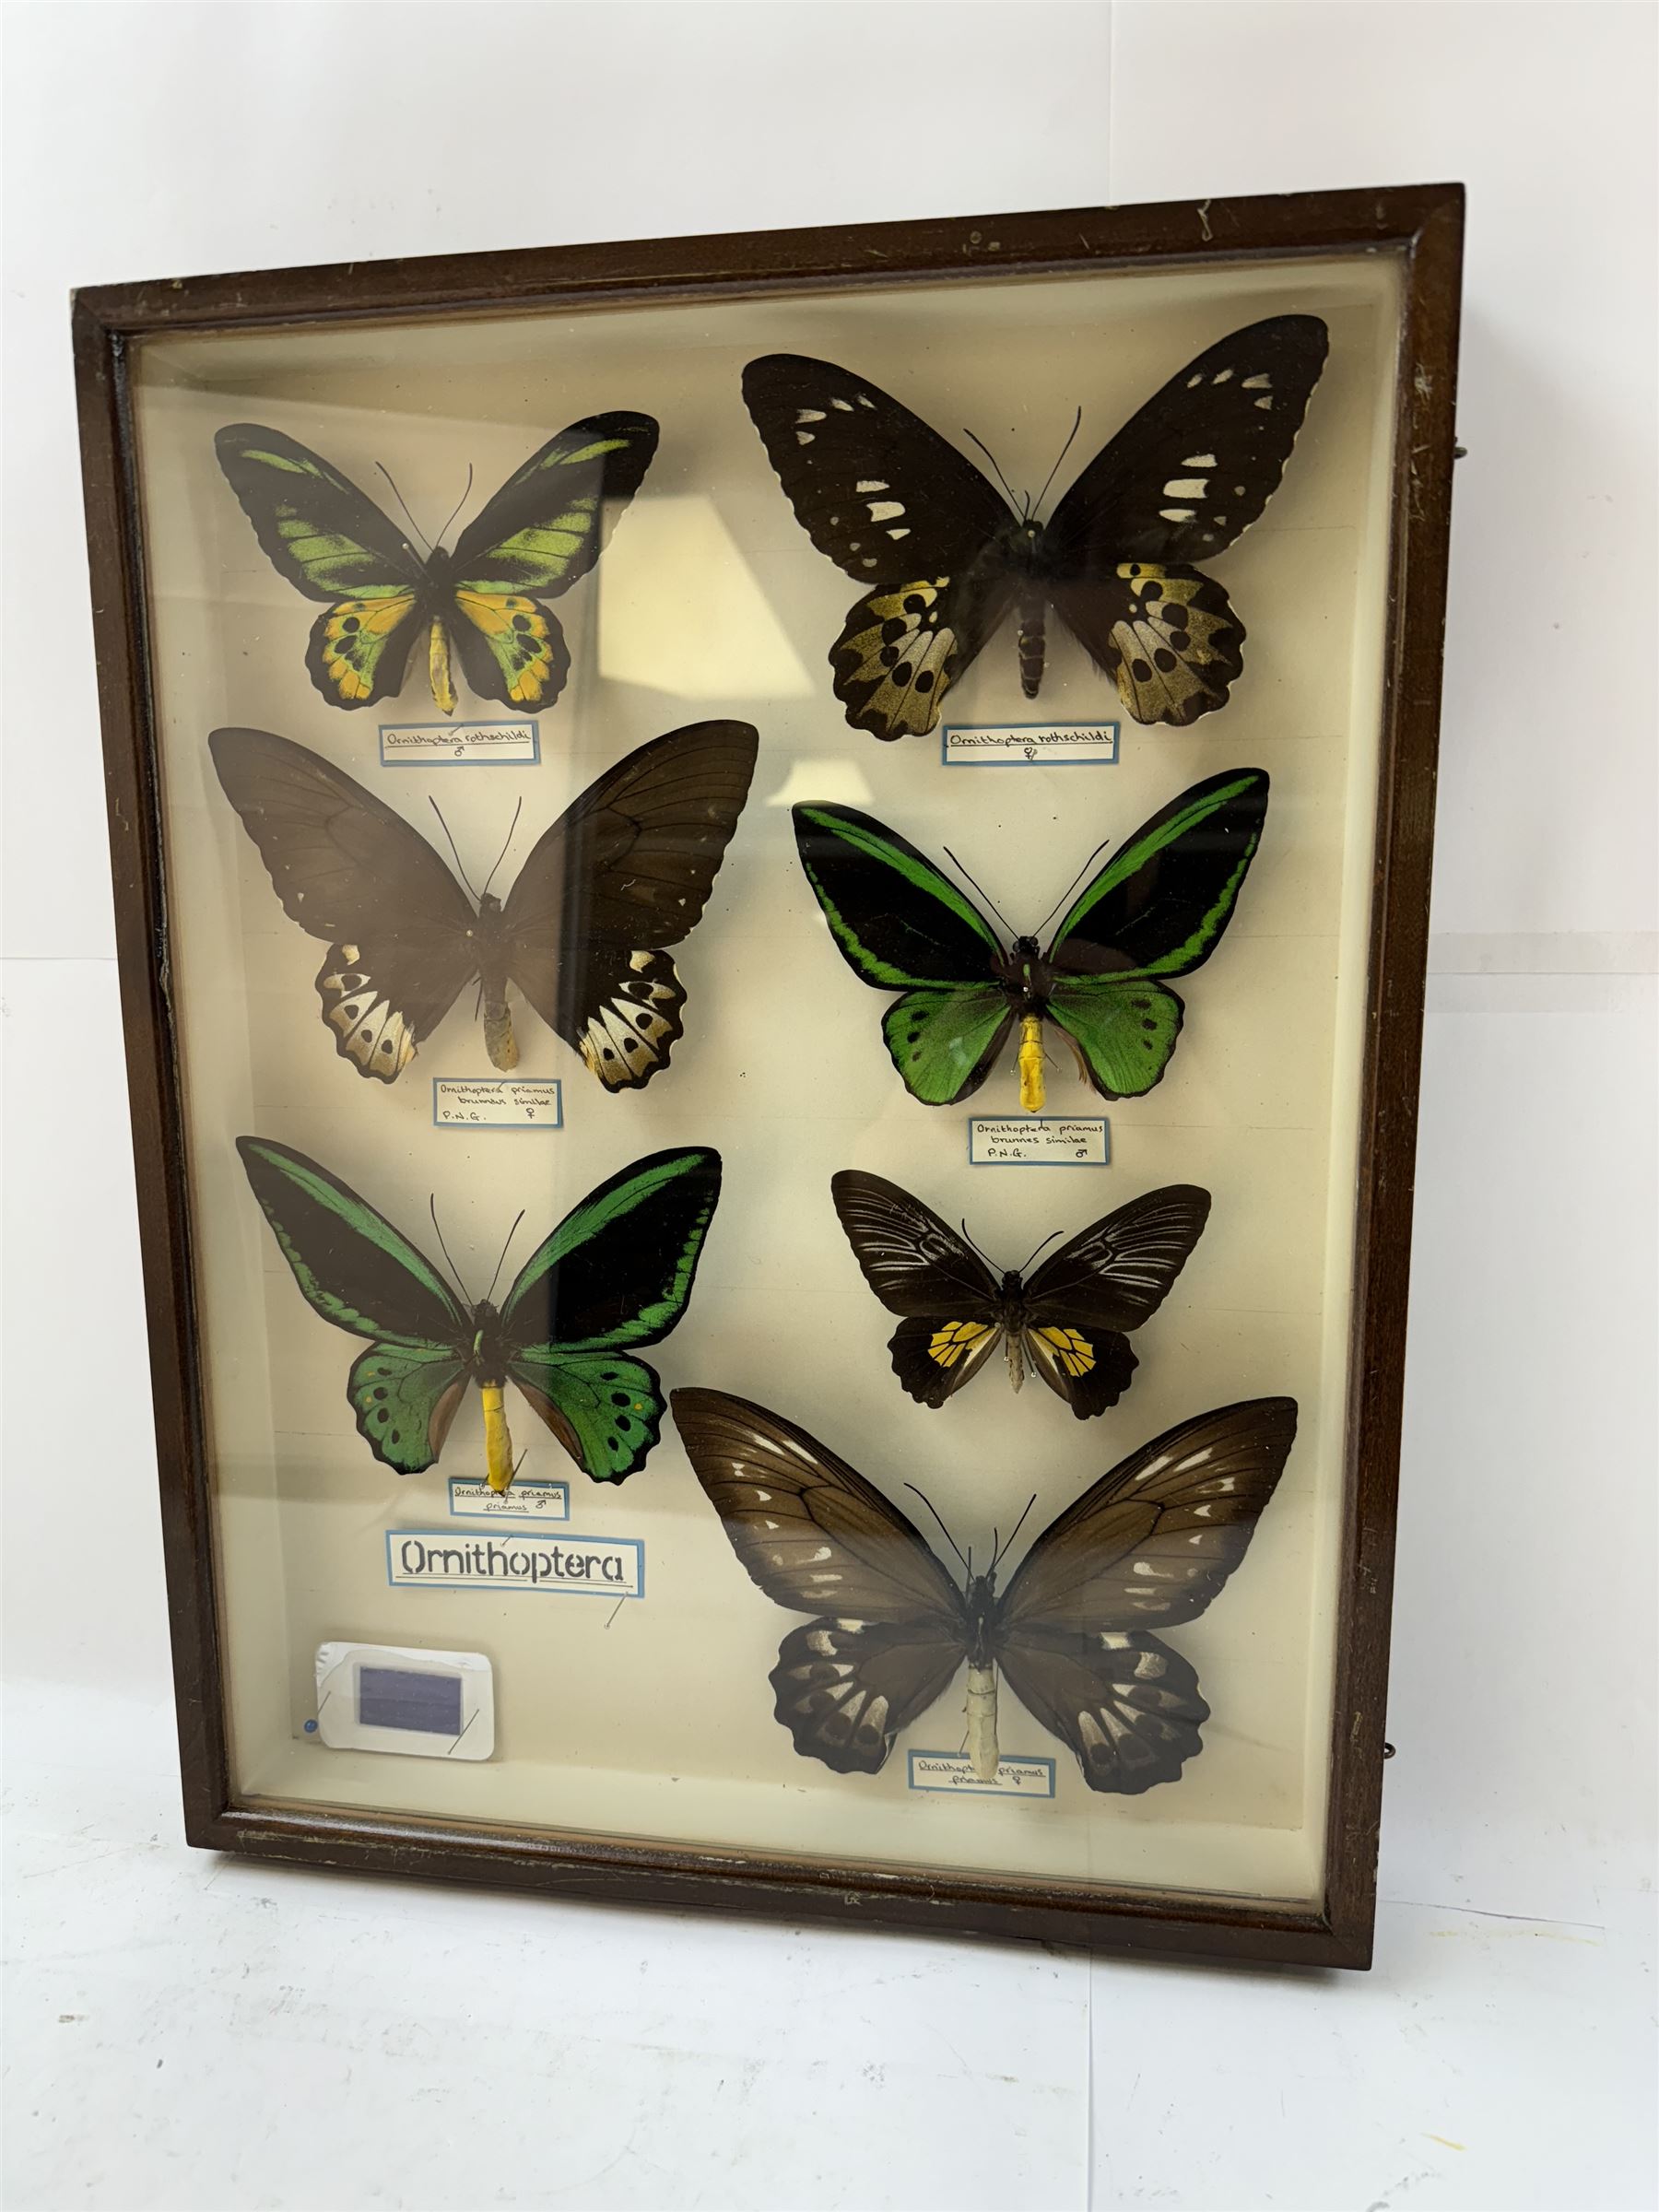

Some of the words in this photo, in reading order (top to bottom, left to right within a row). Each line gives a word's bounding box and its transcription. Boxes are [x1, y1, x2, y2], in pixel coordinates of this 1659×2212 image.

[387, 733, 462, 747] Ornithoptera
[465, 730, 532, 742] rothschildi
[950, 734, 1036, 747] Ornithoptera
[1039, 730, 1112, 743] rothschildi
[441, 1084, 503, 1096] Ornithoptera
[511, 1086, 555, 1095] priamus
[977, 1124, 1051, 1135] Ornithoptera
[1059, 1124, 1103, 1135] priamus
[987, 1147, 1027, 1158] P.N.G.
[521, 1489, 561, 1500] priamus
[485, 1502, 527, 1512] priamus
[401, 1540, 625, 1583] Ornithoptera
[998, 1766, 1043, 1776] priamus
